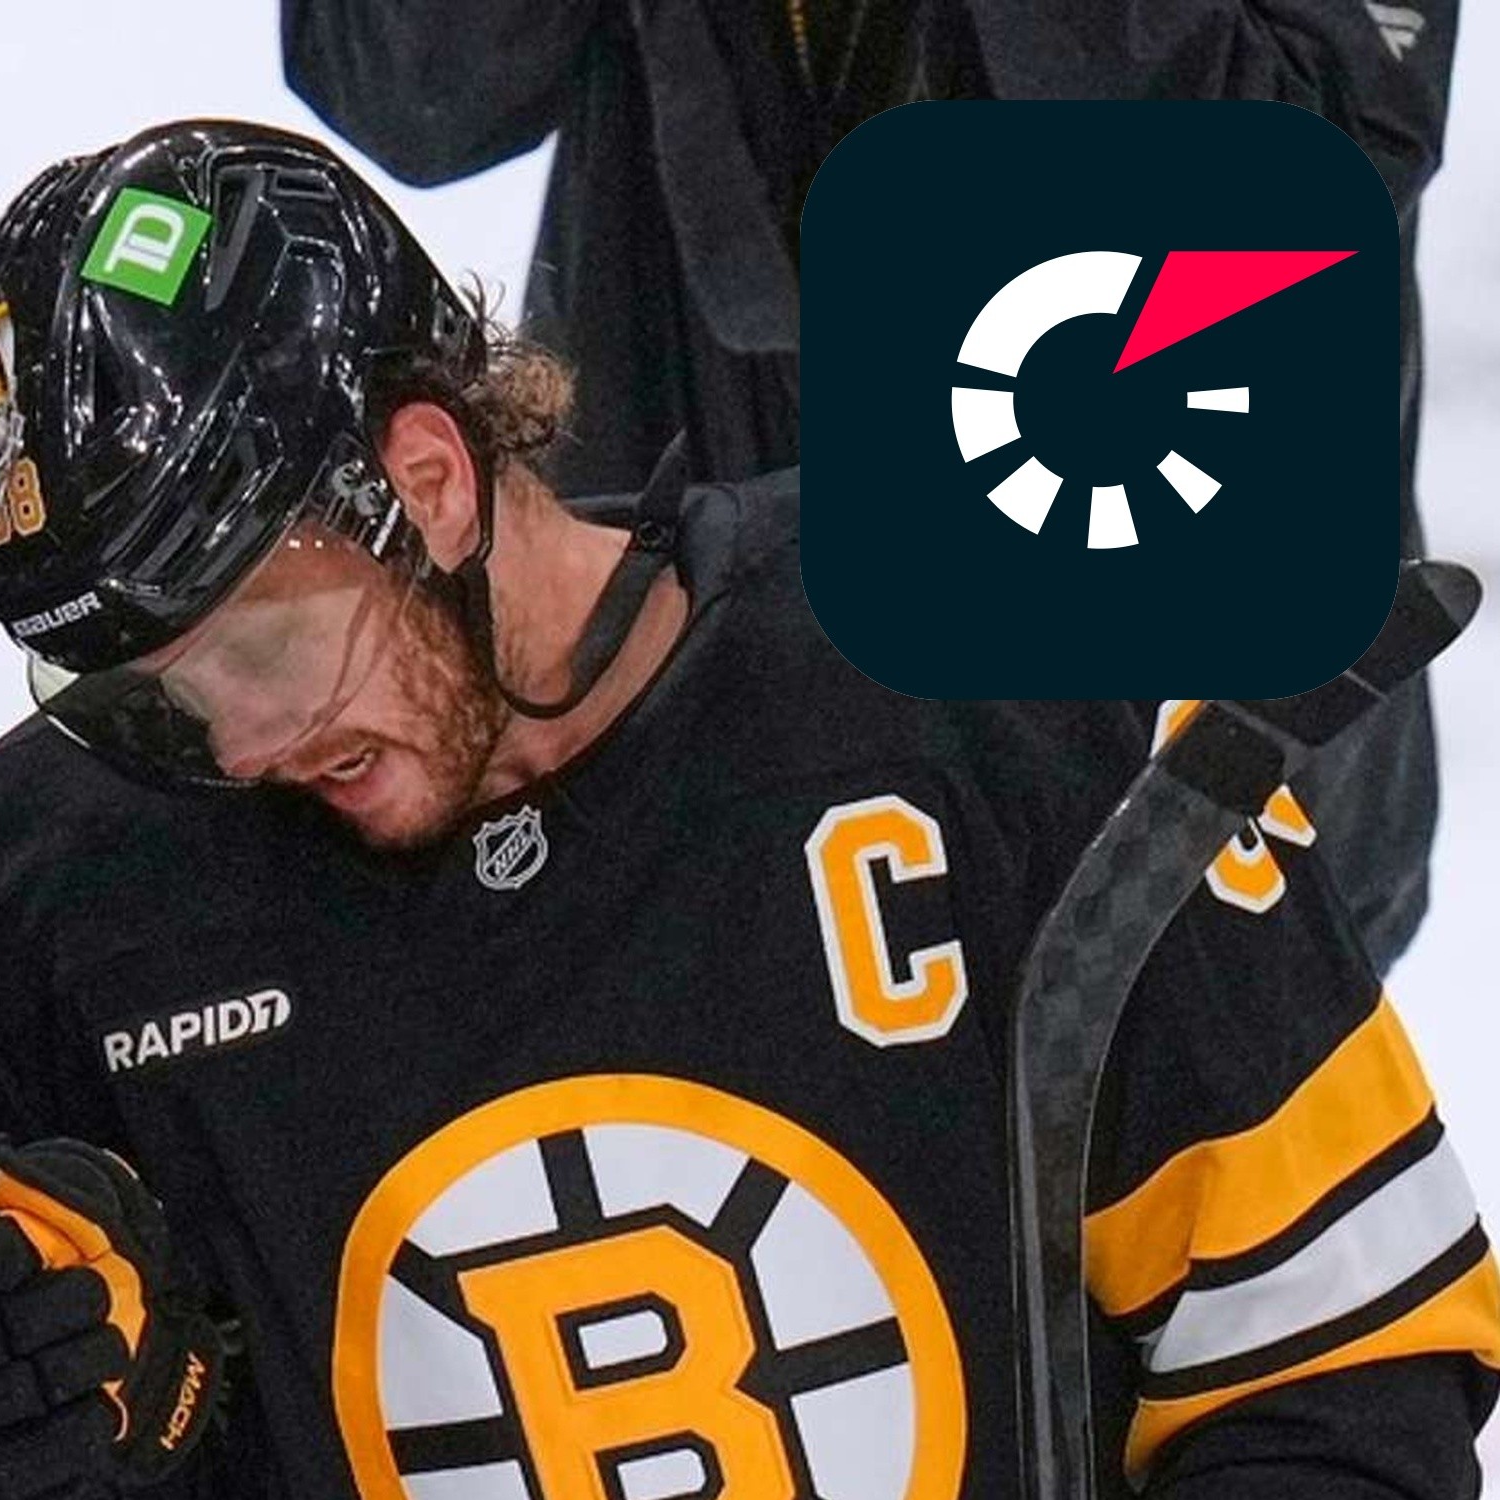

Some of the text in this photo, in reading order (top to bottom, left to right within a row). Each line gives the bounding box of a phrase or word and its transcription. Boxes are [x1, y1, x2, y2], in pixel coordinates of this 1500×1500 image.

[103, 203, 184, 273] TD
[805, 795, 968, 1048] C
[103, 988, 292, 1073] RAPID7
